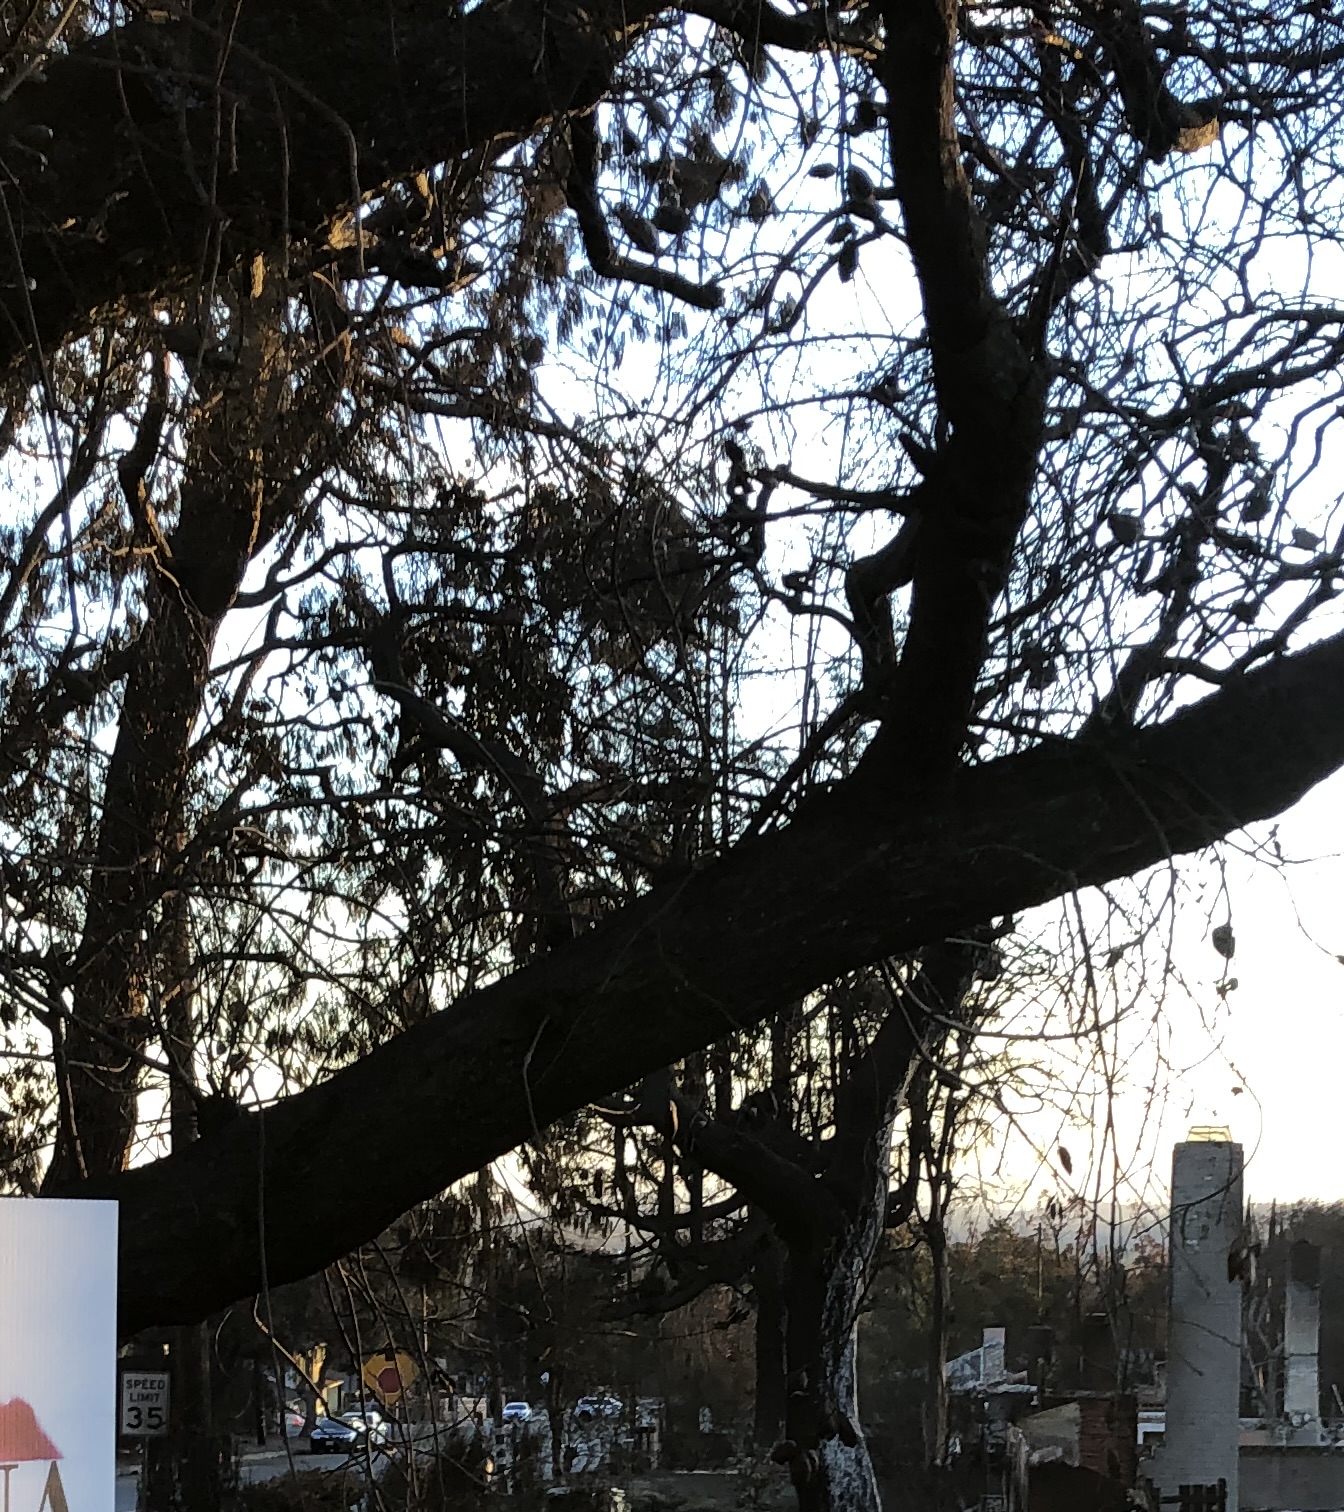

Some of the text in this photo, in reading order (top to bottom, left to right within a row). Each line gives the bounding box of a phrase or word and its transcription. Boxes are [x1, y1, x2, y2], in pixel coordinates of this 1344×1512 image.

[126, 1379, 166, 1390] SPEED
[129, 1392, 160, 1402] LIMIT
[126, 1406, 164, 1430] 35
